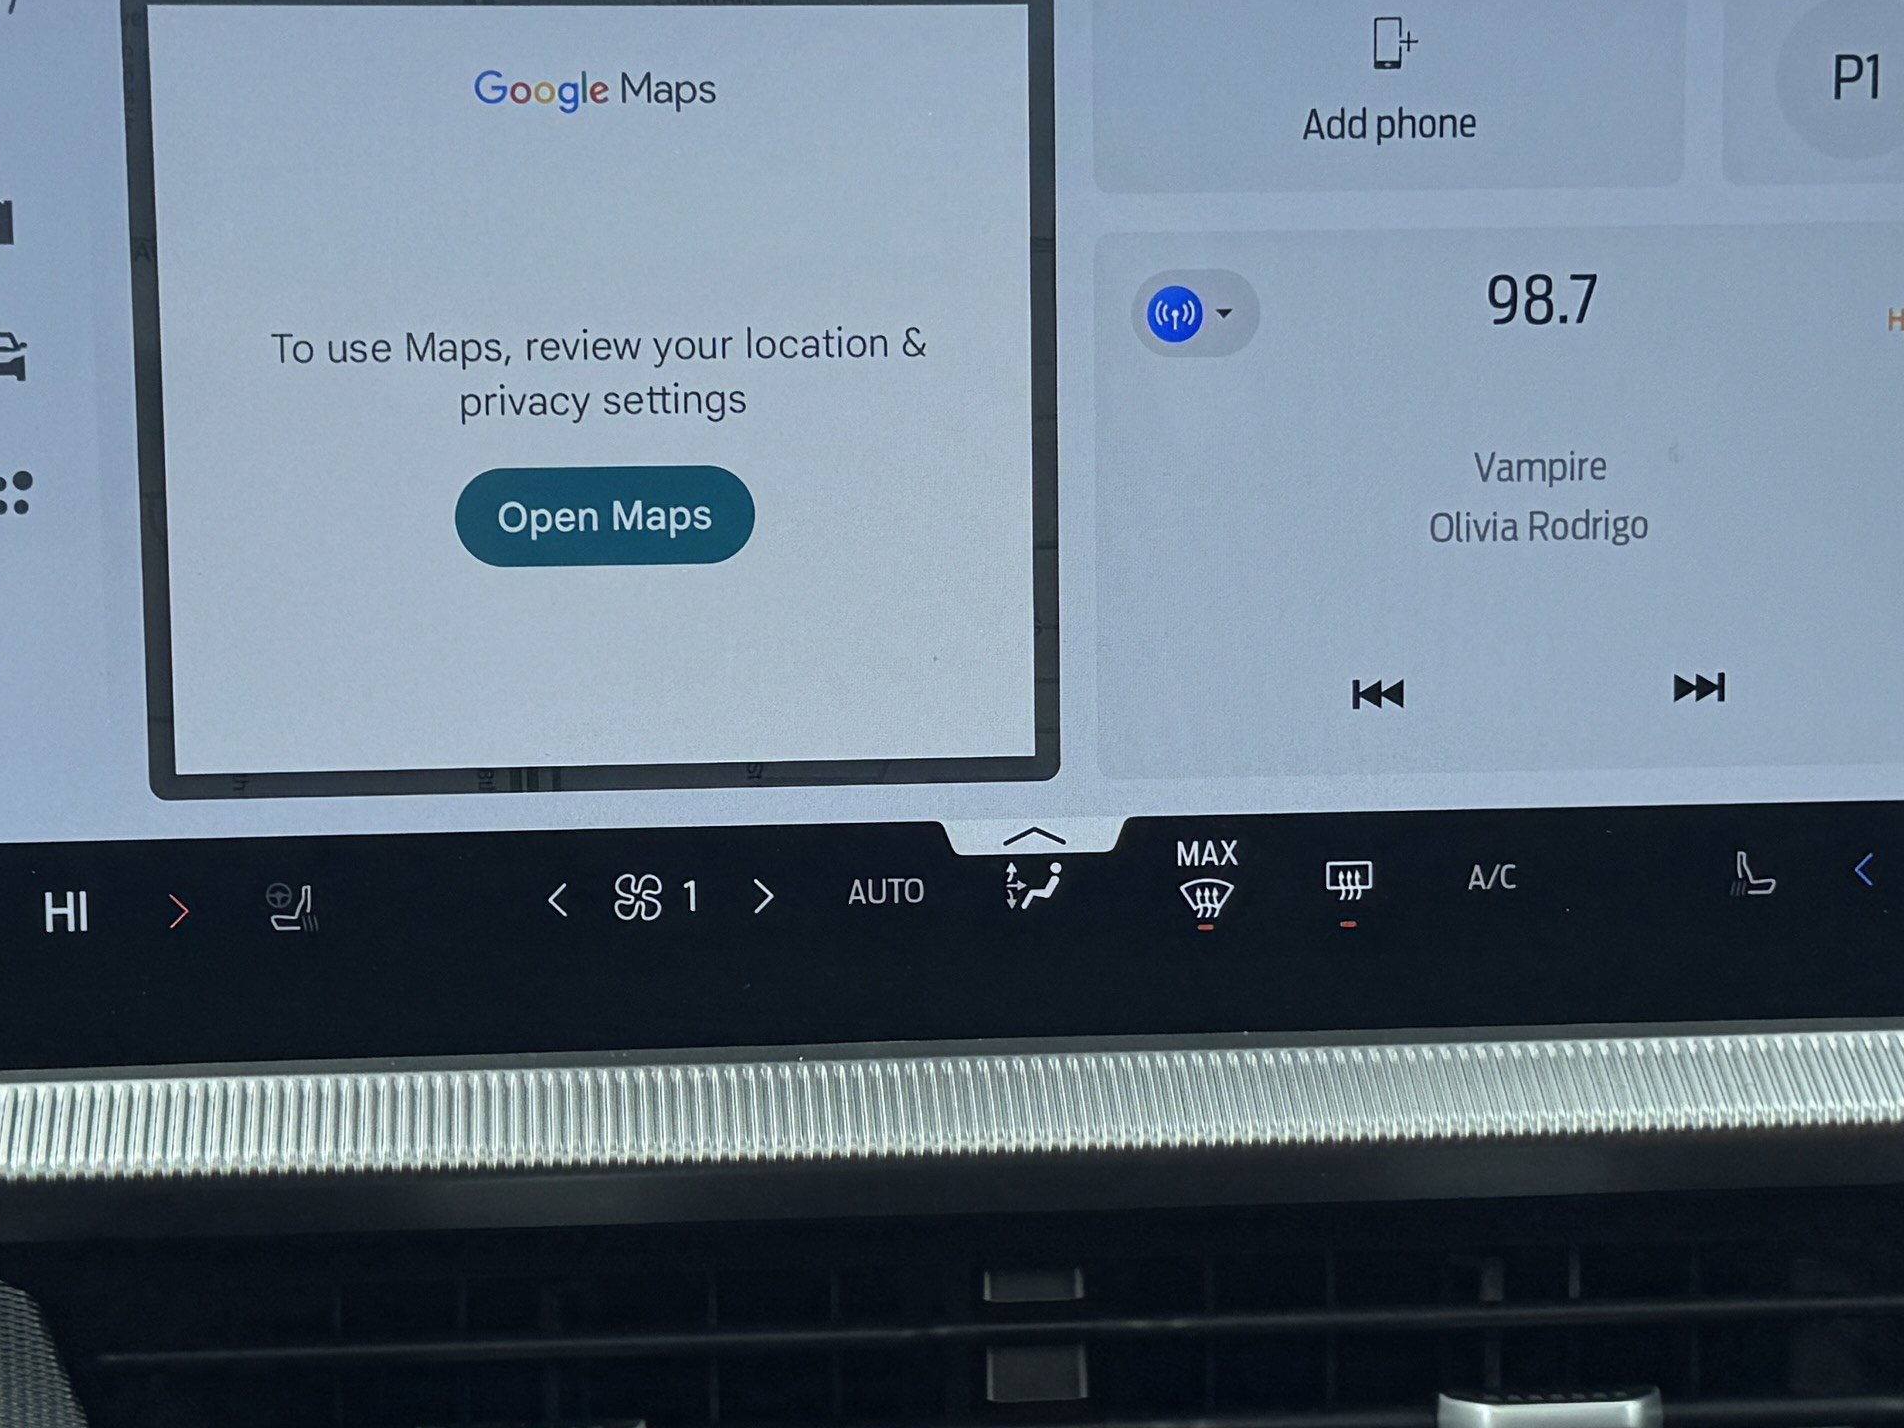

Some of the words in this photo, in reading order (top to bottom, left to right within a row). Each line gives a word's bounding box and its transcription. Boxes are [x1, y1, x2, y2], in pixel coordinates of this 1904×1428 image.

[473, 68, 610, 114] Google
[620, 70, 718, 113] Maps
[1832, 53, 1881, 100] P1
[1302, 105, 1368, 141] Add
[1375, 105, 1478, 146] phone
[1487, 272, 1599, 327] 98.7
[270, 332, 315, 365] To
[327, 338, 393, 365] use
[405, 331, 513, 371] Maps,
[525, 327, 643, 363] review
[651, 335, 734, 369] your
[745, 324, 889, 360] location
[901, 325, 927, 359] &
[459, 382, 592, 426] privacy
[602, 380, 748, 424] settings
[1473, 449, 1608, 488] Vampire
[497, 500, 600, 541] Open
[611, 498, 713, 539] Maps
[1429, 509, 1520, 544] Olivia
[1528, 507, 1650, 547] Rodrigo
[1176, 838, 1239, 868] MAX
[682, 879, 697, 913] 1
[847, 876, 926, 906] AUTO
[1467, 862, 1518, 891] A/C
[43, 889, 89, 933] HI
